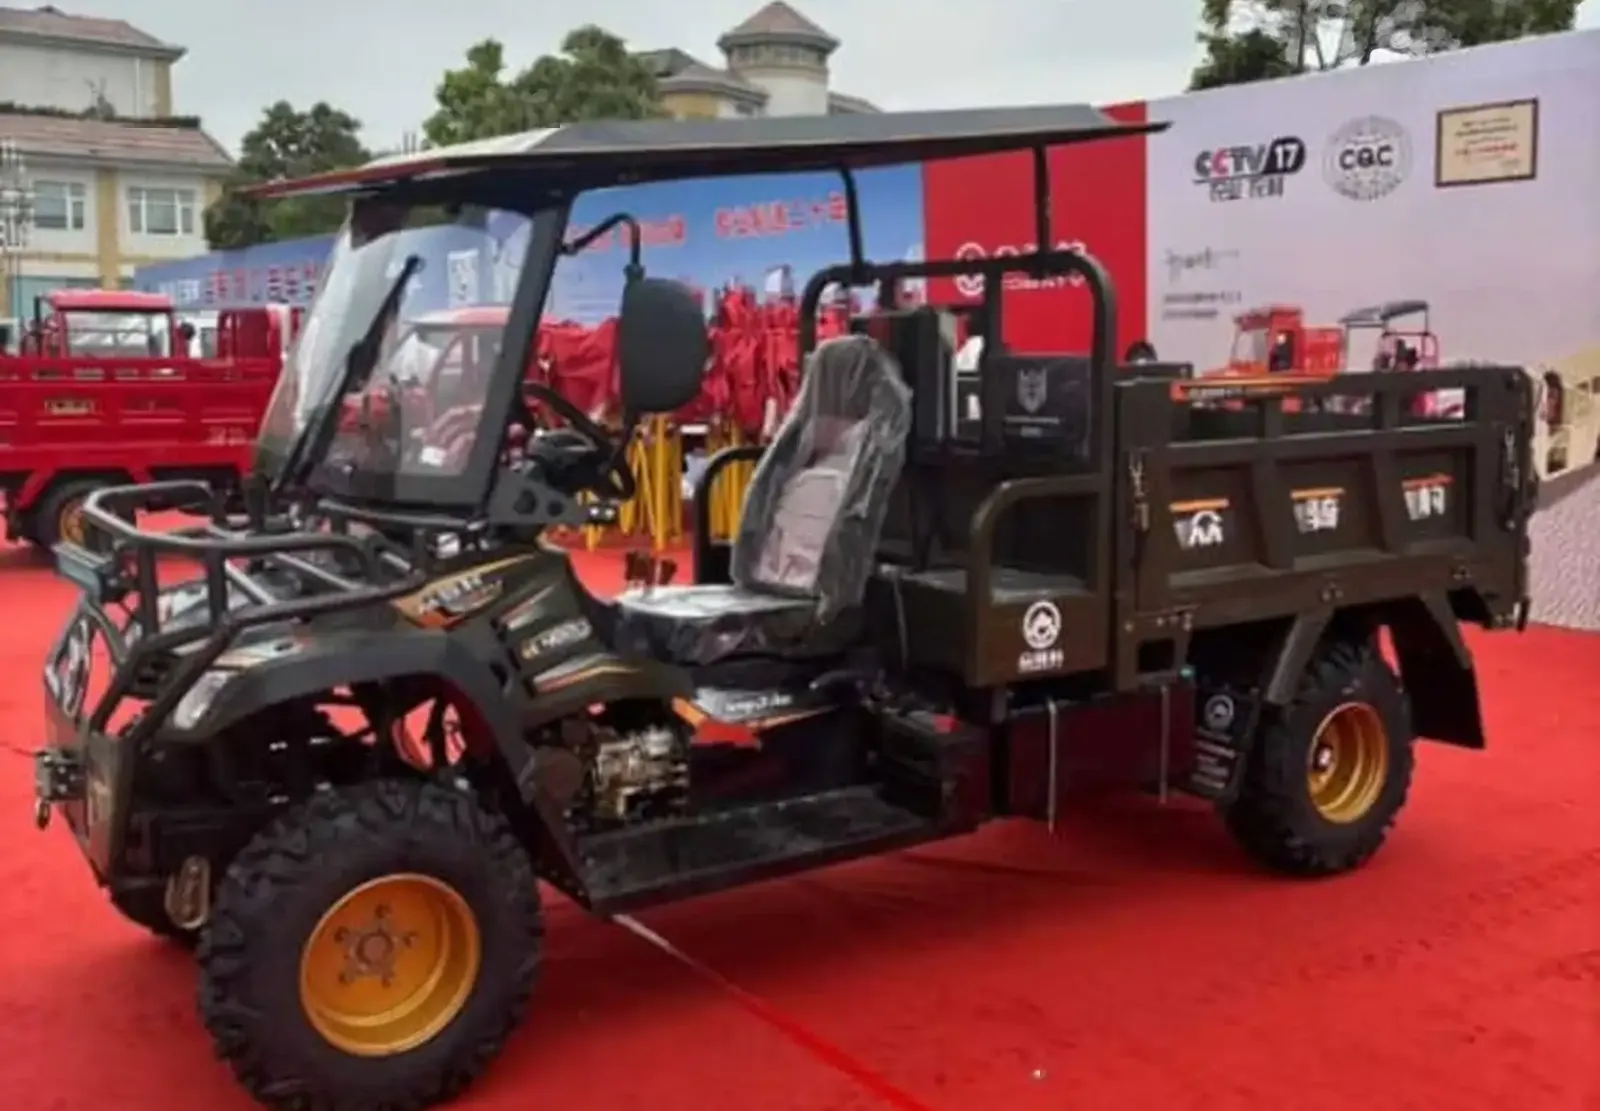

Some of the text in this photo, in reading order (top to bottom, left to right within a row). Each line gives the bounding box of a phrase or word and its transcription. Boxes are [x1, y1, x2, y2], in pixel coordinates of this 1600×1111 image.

[1195, 144, 1299, 177] CCTV 17
[1339, 144, 1394, 171] CQC
